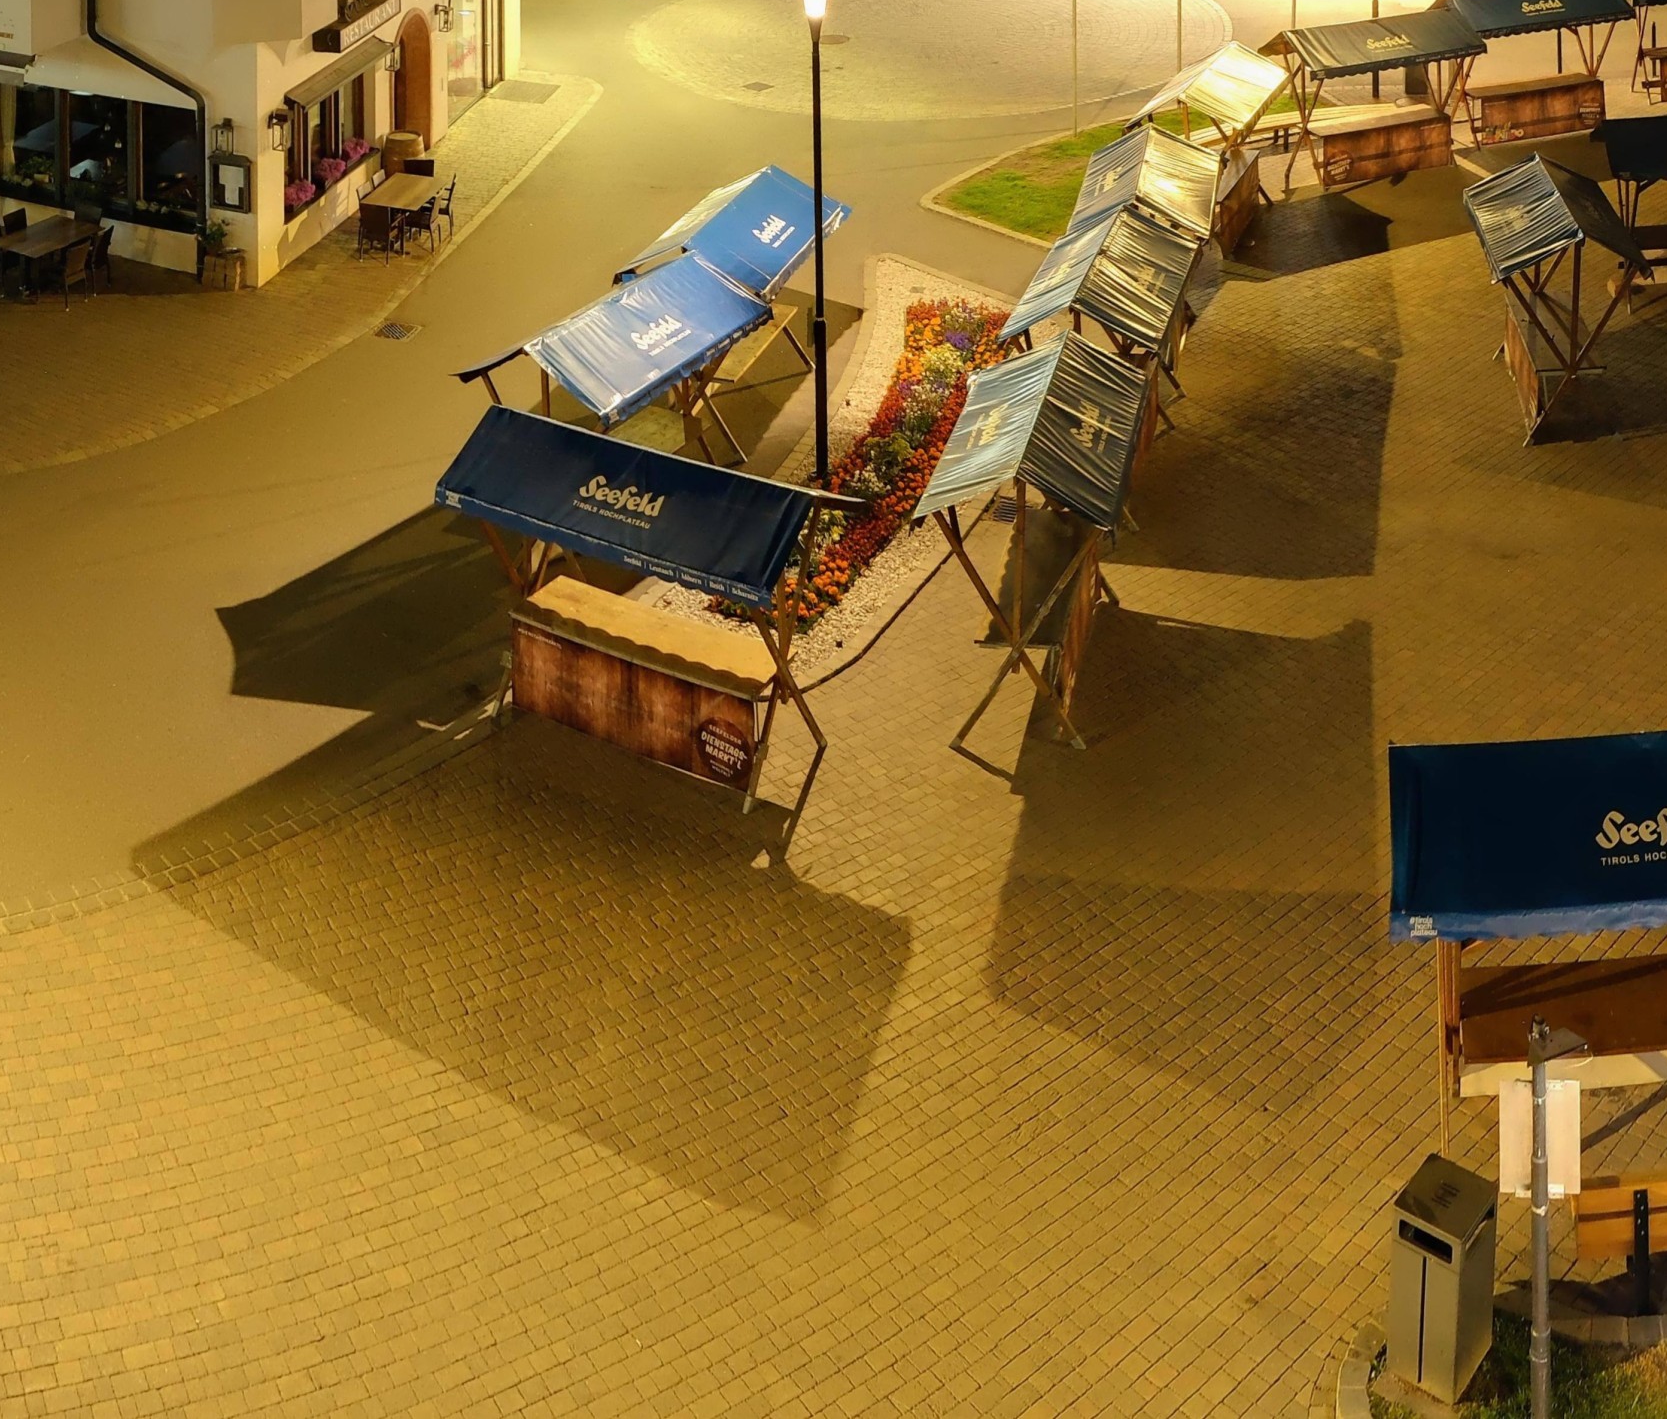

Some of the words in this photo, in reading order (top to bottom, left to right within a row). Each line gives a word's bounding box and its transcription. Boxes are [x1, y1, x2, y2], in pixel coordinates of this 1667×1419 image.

[1520, 0, 1565, 14] Seefeld
[343, 0, 399, 47] RESTAURANT
[1366, 34, 1411, 51] Seefeld
[631, 314, 683, 350] Seefeld
[579, 475, 665, 518] Seefeld
[572, 499, 598, 512] TIROLS
[599, 507, 651, 529] HOCHPLATEAU
[708, 723, 742, 745] SEEFELDER
[701, 731, 747, 760] DIENSTAGS-
[705, 743, 742, 770] MARKT'L
[1600, 853, 1640, 866] TIROLS
[1409, 916, 1433, 927] #tirols
[1414, 922, 1433, 931] hoch
[1410, 928, 1438, 938] plateau
